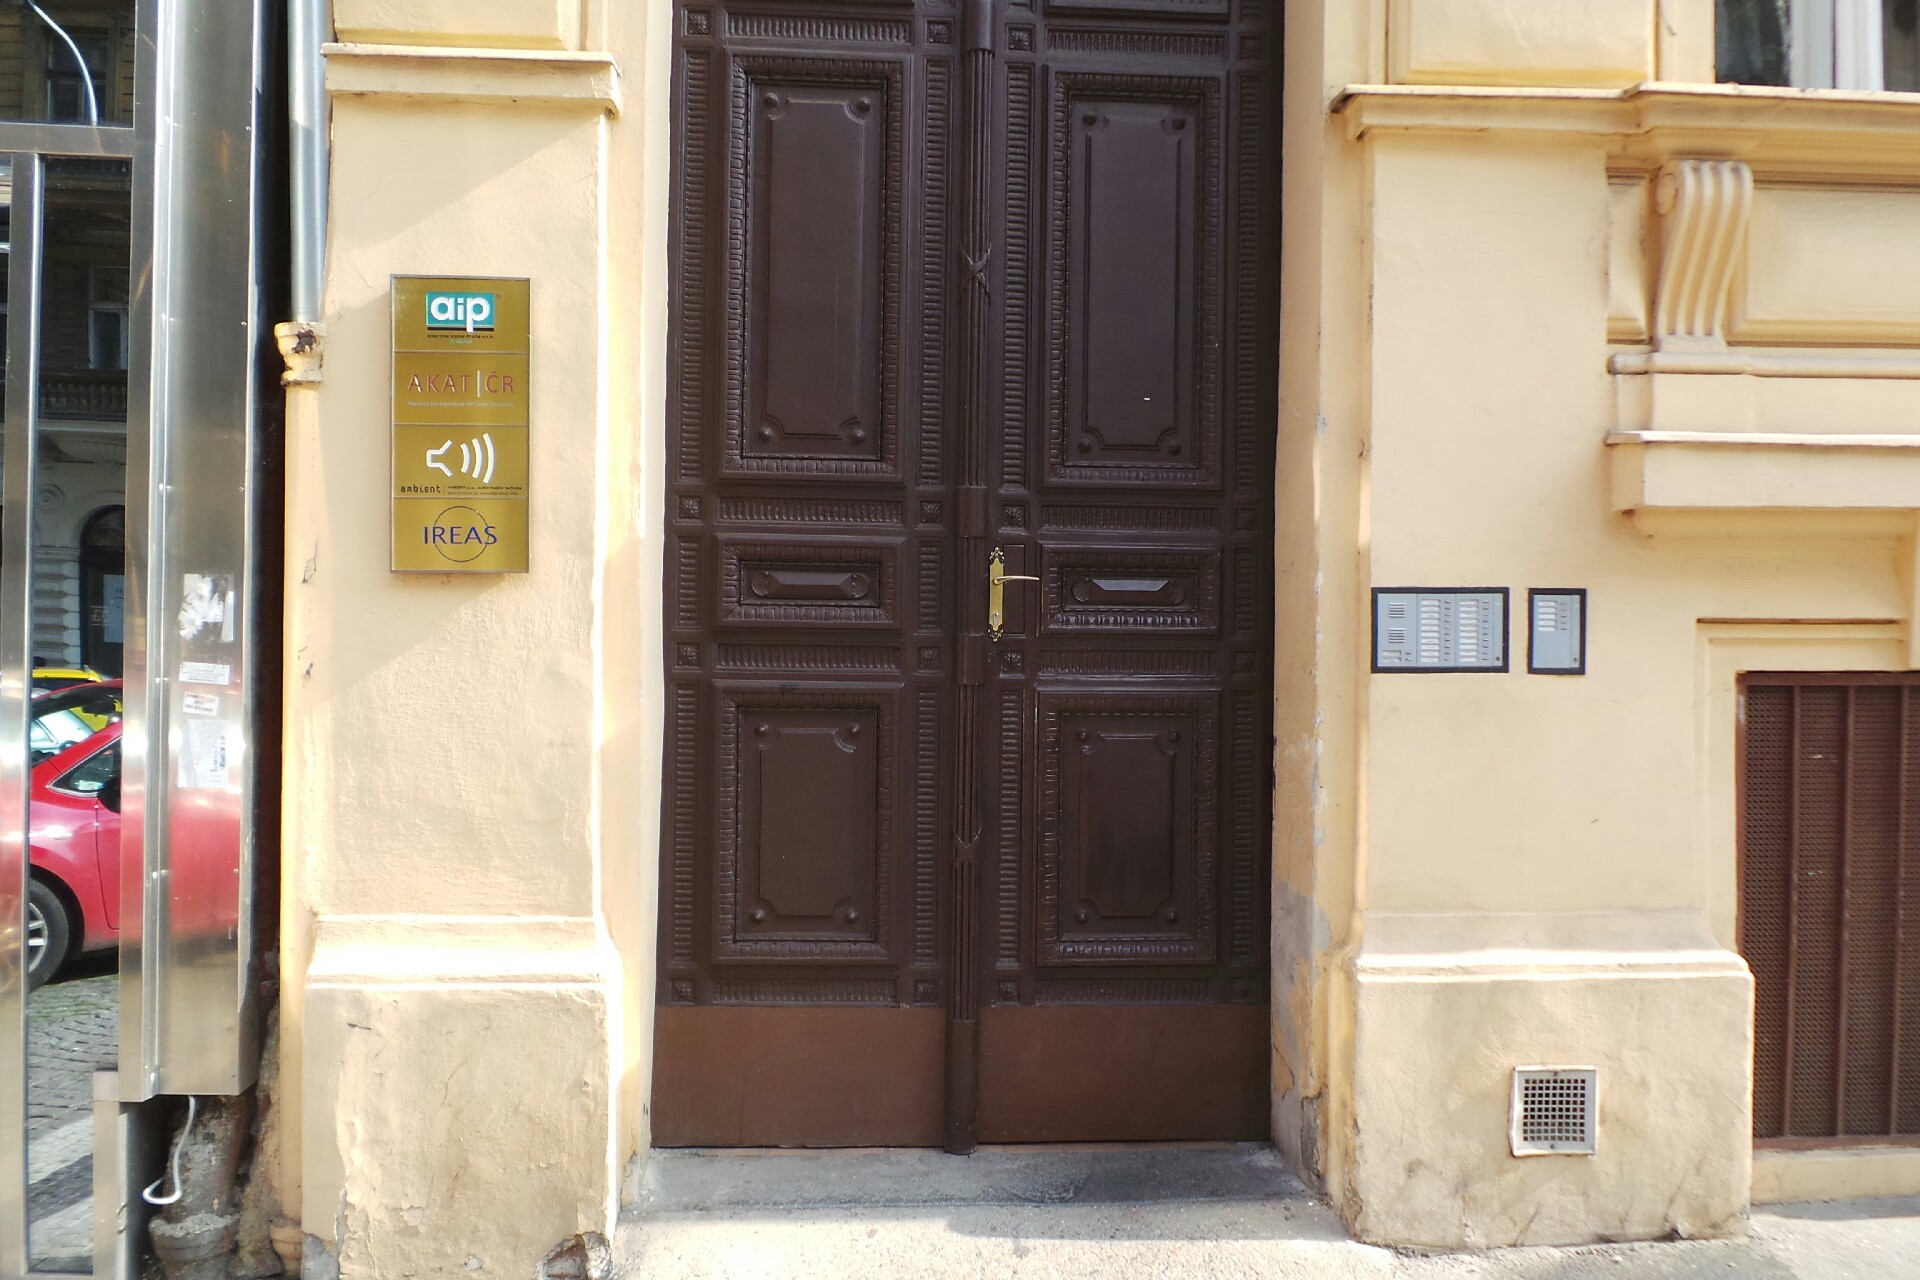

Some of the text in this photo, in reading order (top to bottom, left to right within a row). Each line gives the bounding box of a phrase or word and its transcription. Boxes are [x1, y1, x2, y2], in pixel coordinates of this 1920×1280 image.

[431, 296, 491, 333] aip
[408, 371, 514, 394] AKAT ČR
[400, 484, 441, 493] ambient
[424, 526, 498, 545] IREAS
